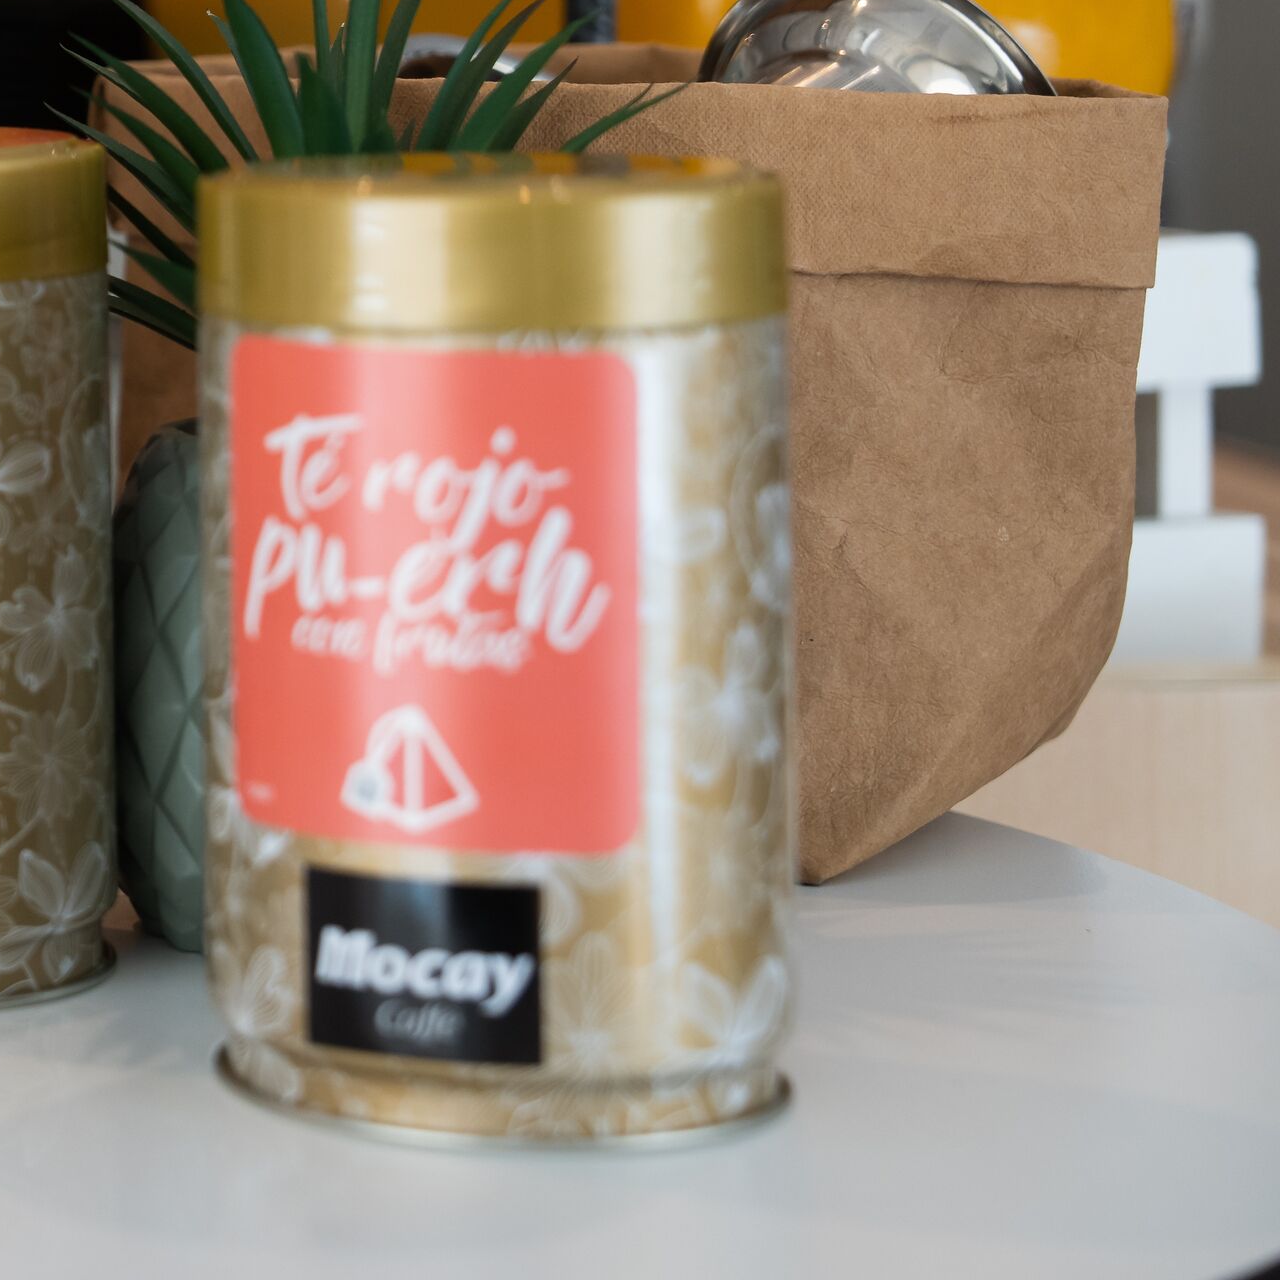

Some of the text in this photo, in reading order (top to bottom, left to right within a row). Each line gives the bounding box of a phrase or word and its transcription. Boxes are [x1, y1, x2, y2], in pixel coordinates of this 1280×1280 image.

[263, 412, 571, 554] Té rojo
[315, 923, 535, 1017] Mocay
